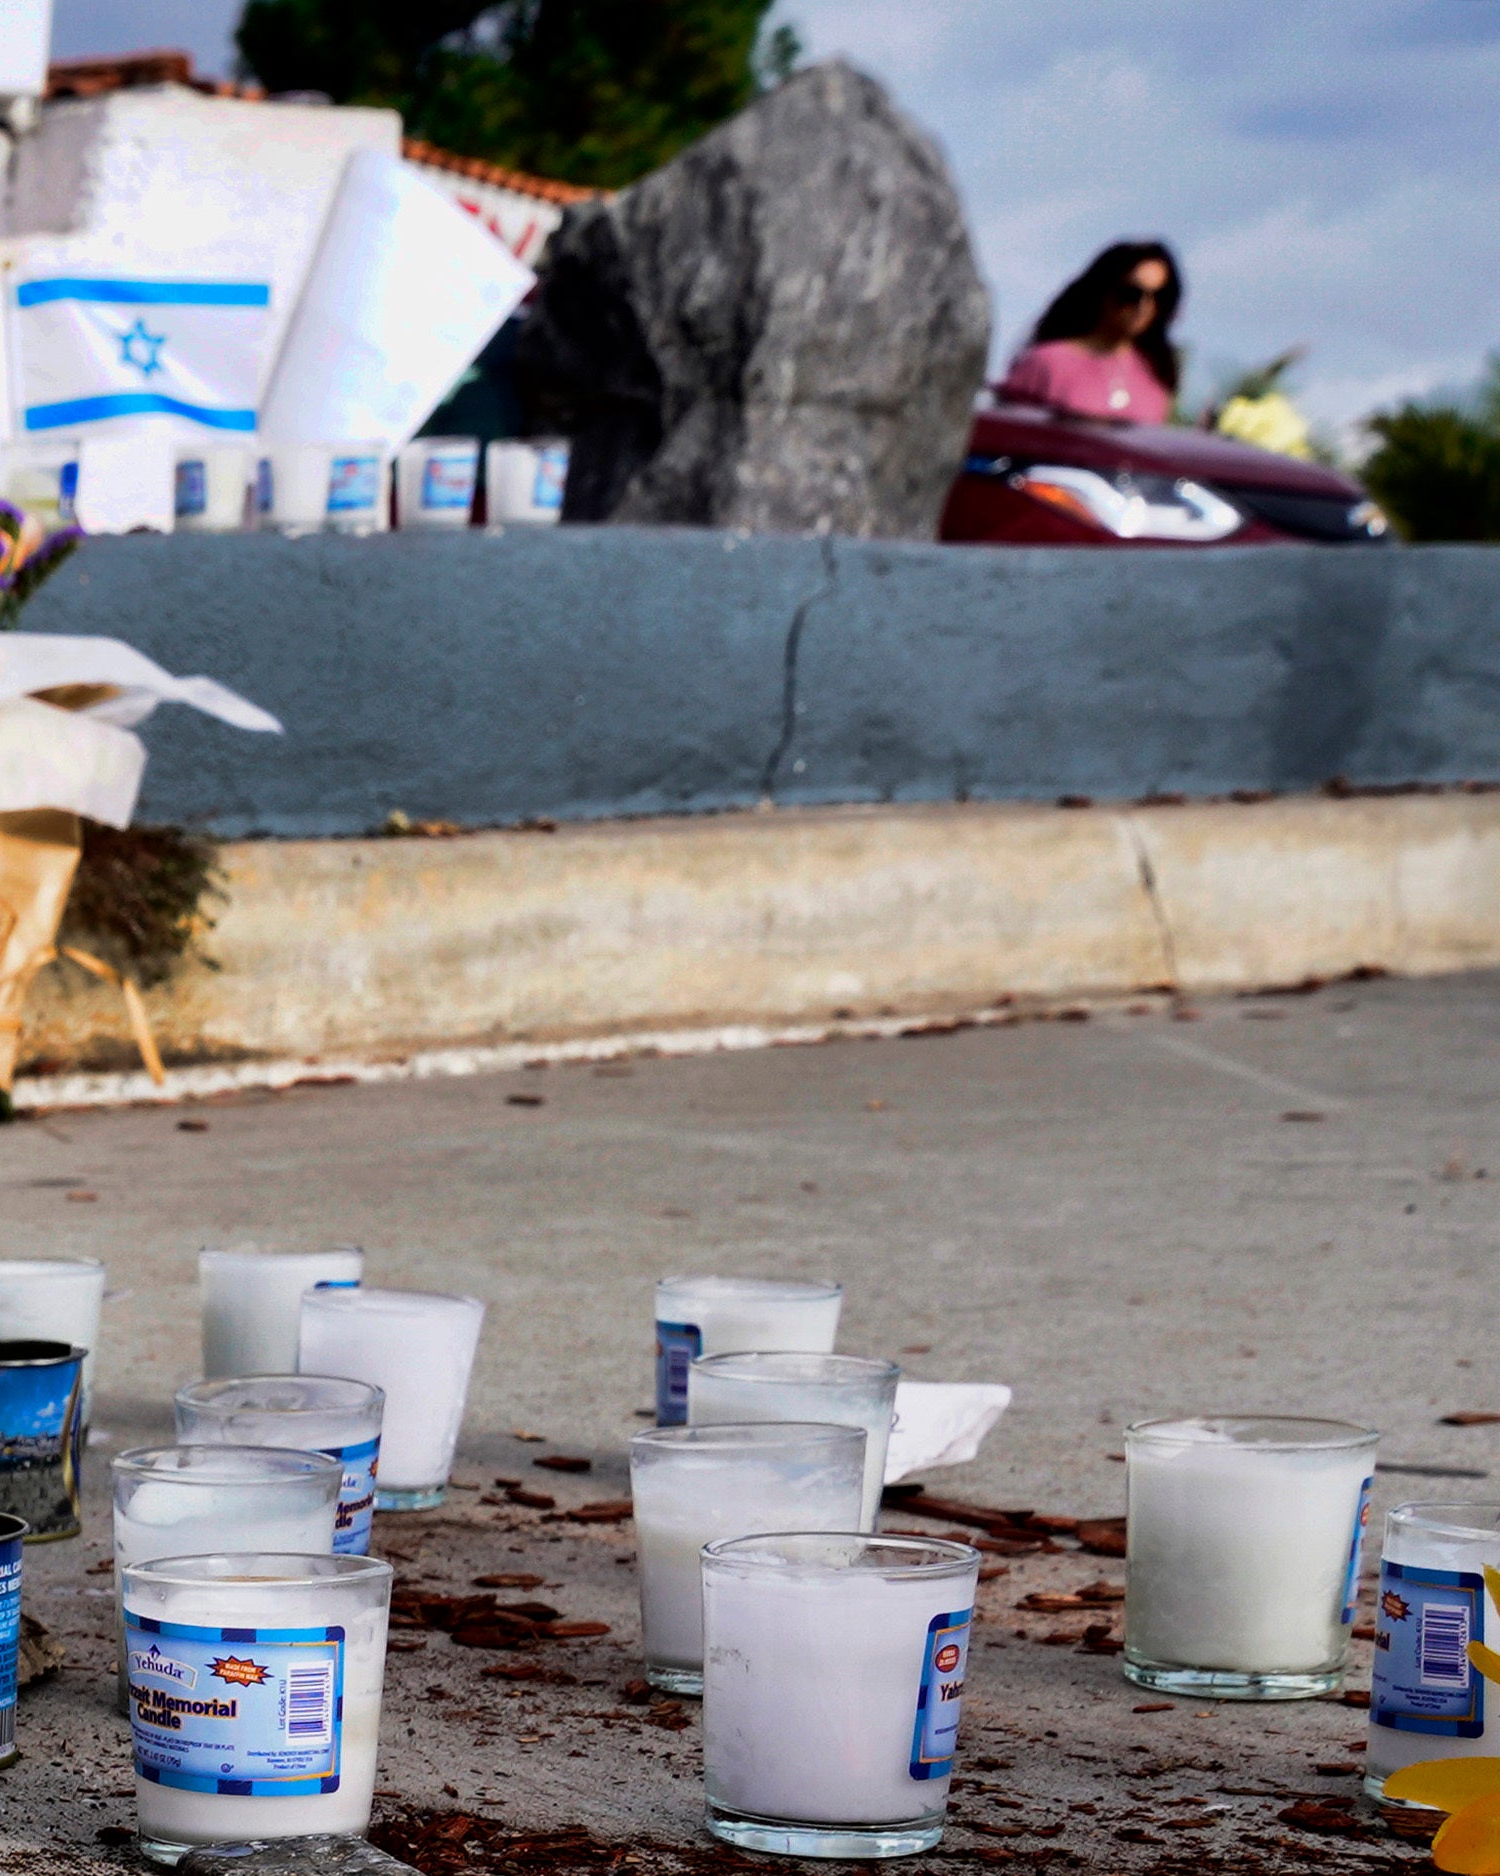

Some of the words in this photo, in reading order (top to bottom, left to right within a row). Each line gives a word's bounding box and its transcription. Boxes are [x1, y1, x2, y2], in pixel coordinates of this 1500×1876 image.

[134, 1655, 185, 1681] Yehuda
[137, 1703, 182, 1730] Candle
[152, 1690, 237, 1718] Memorial
